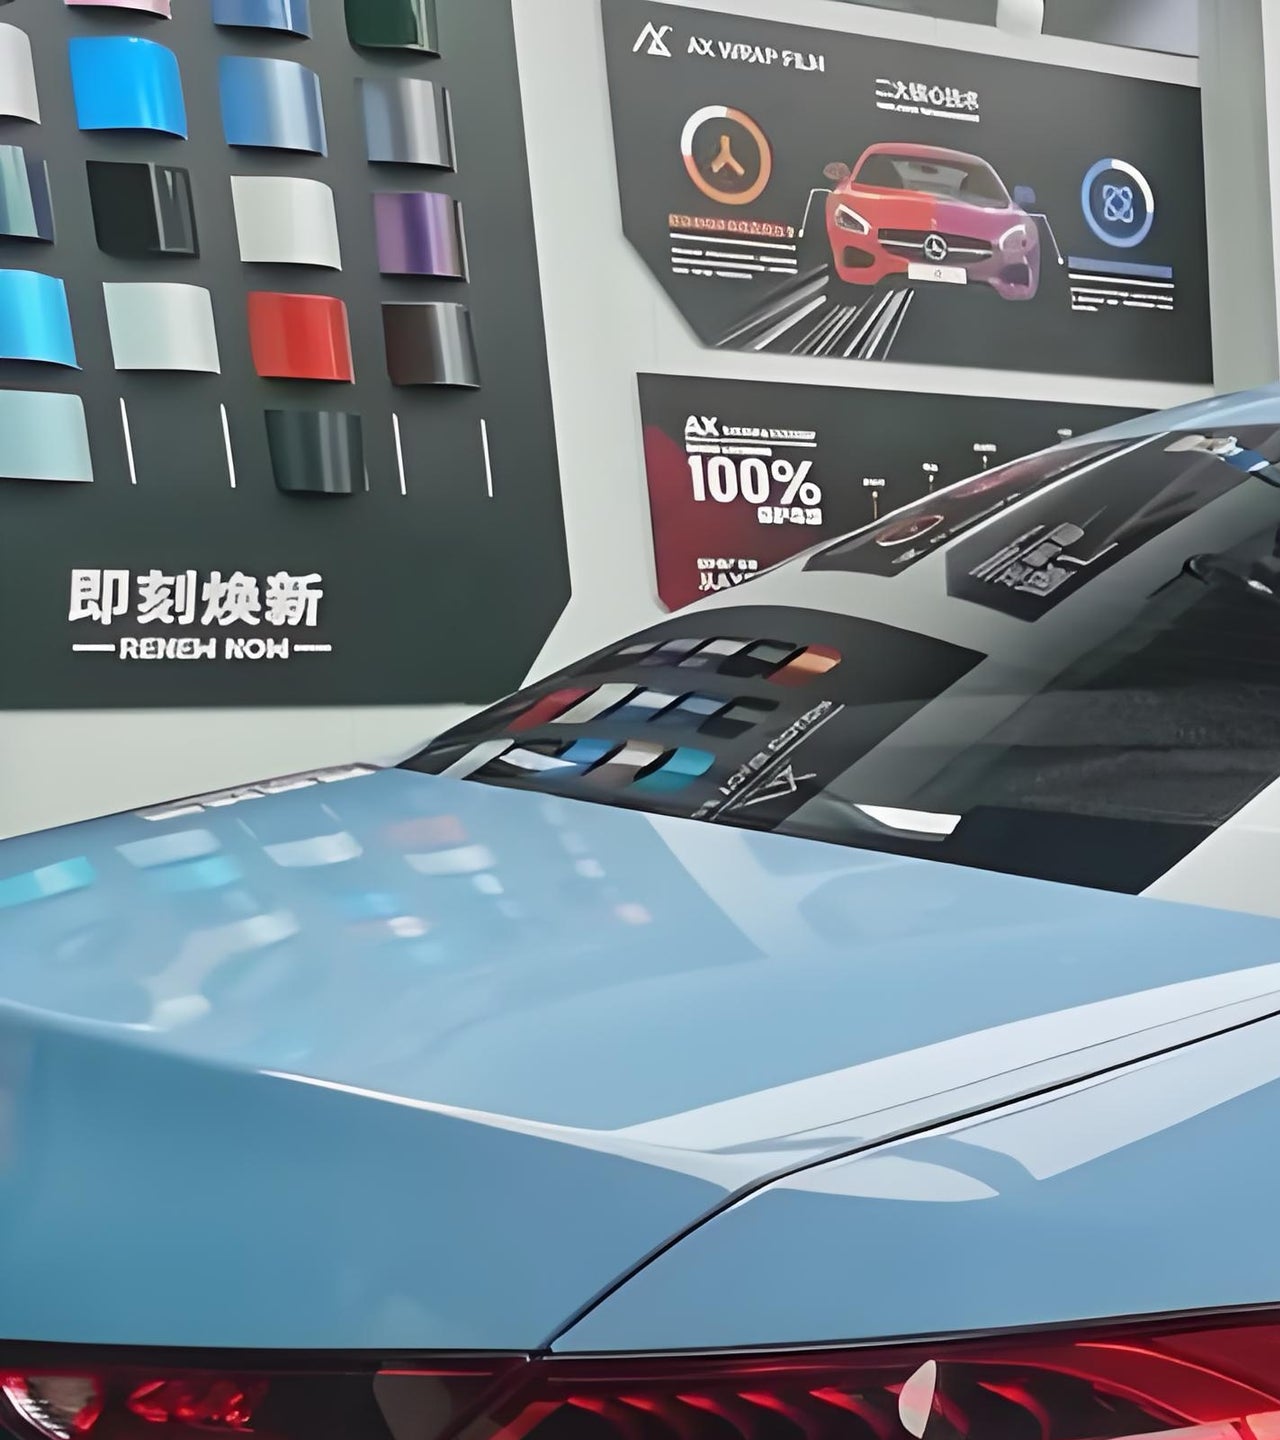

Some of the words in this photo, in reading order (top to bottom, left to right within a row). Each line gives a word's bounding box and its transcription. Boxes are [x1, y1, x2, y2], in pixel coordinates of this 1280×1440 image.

[685, 415, 720, 436] AX
[687, 454, 822, 506] 100%
[68, 568, 324, 627] 即刻焕新
[119, 636, 217, 660] RENEW
[224, 637, 289, 660] NOW
